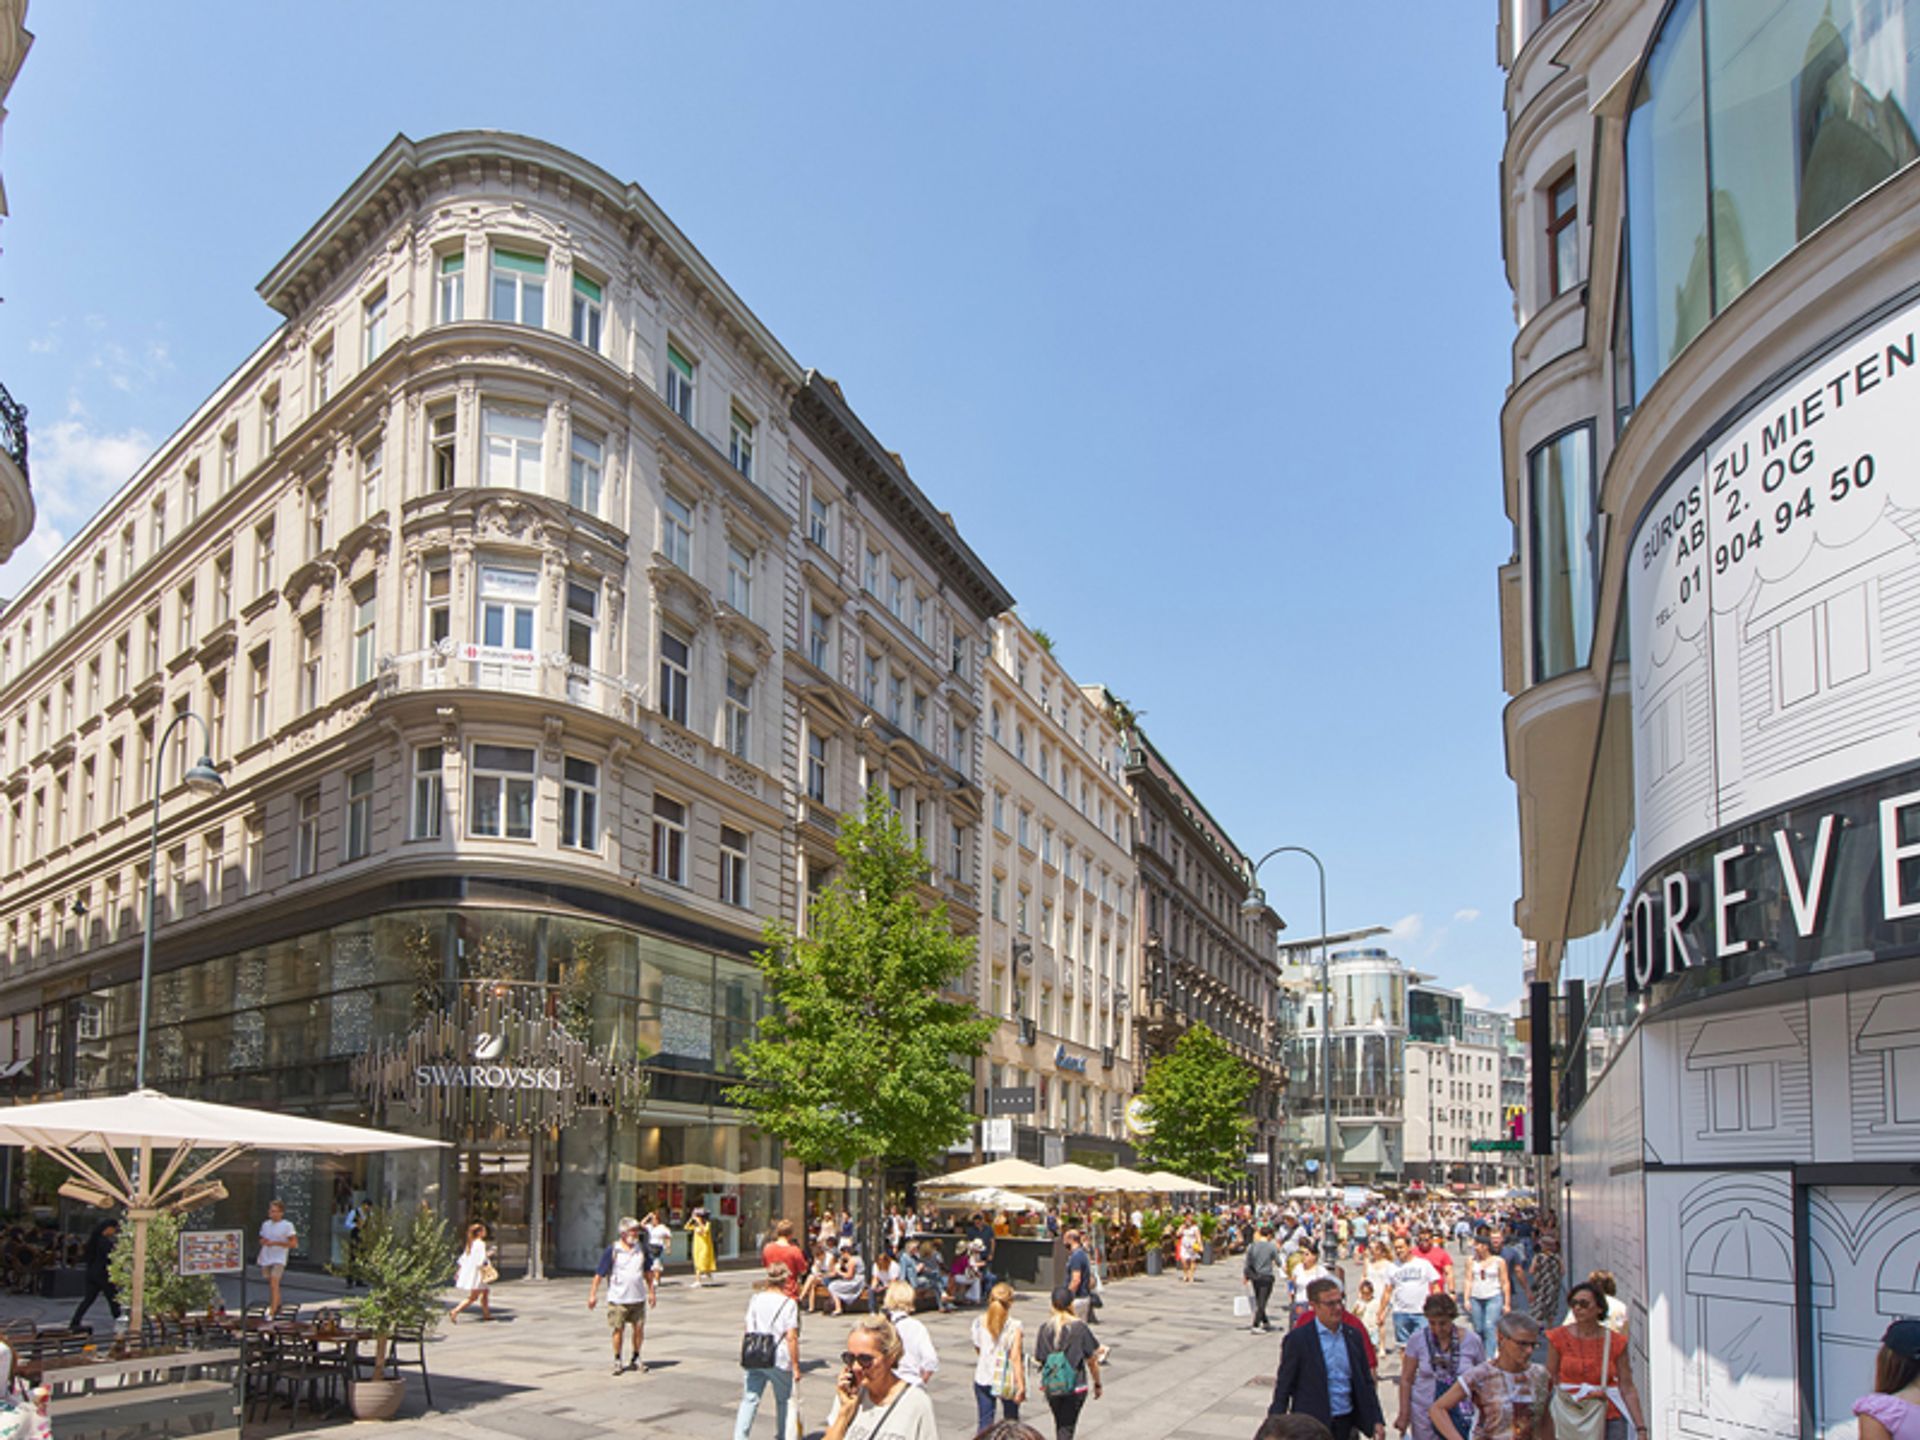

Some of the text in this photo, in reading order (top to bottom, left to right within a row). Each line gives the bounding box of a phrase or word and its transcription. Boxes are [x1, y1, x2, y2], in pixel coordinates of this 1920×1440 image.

[1643, 333, 1916, 570] BÜROS ZU MIETEN
[1675, 439, 1815, 567] AB 2. OG
[1680, 563, 1700, 604] 01
[1715, 520, 1763, 575] 904
[1775, 487, 1815, 535] 94
[1830, 454, 1875, 502] 50
[1624, 790, 1920, 989] OREVE
[416, 1065, 560, 1091] SWAROVSKI
